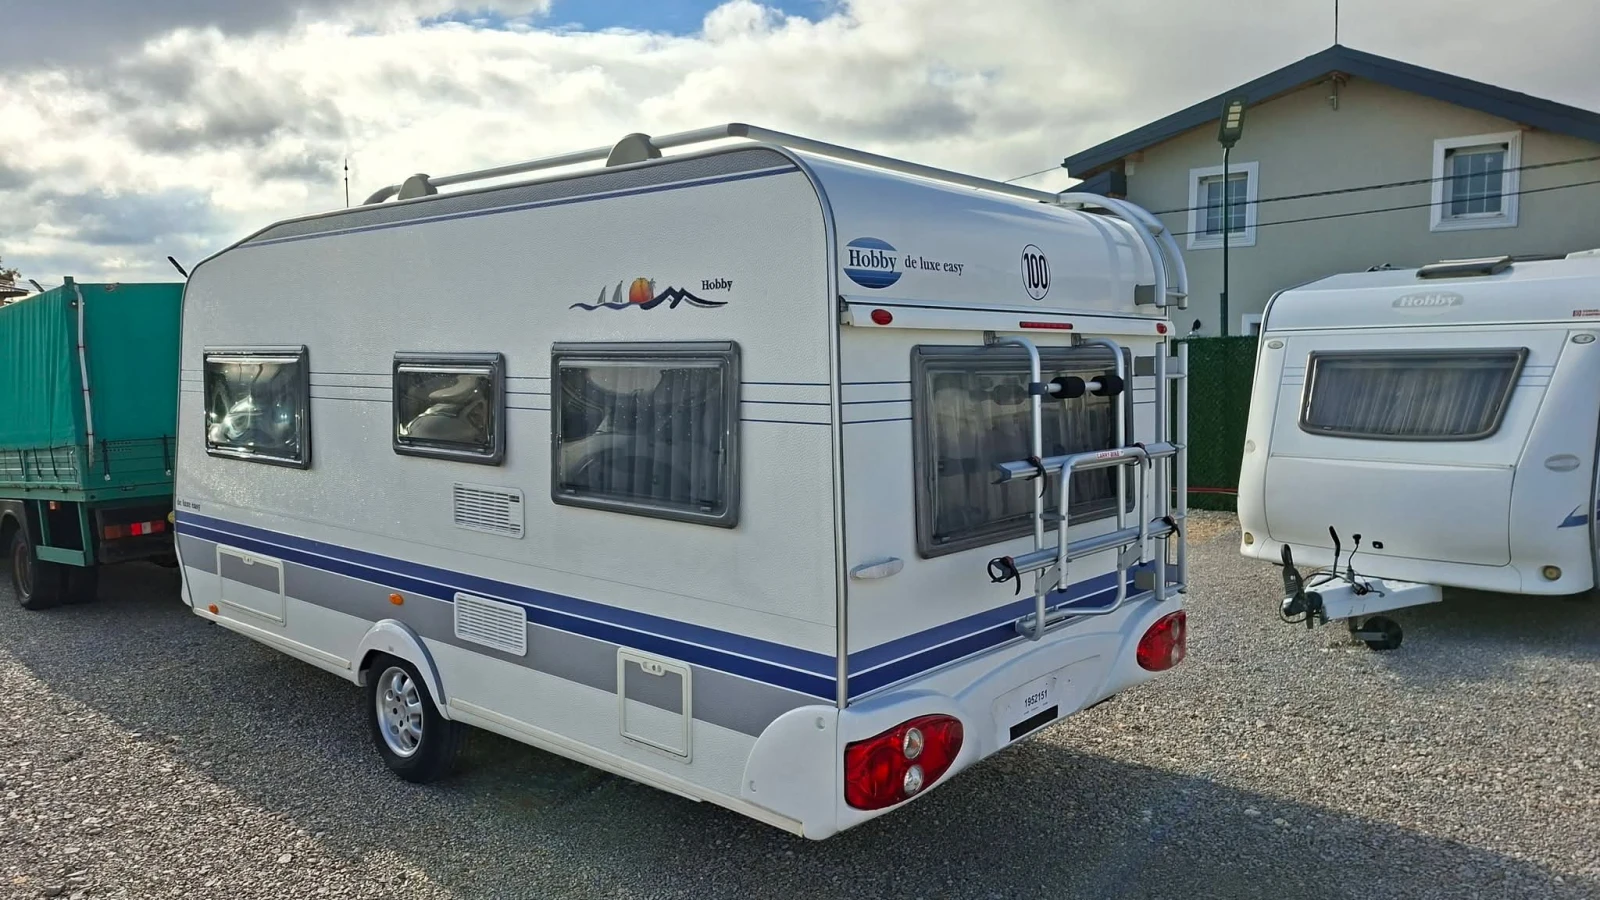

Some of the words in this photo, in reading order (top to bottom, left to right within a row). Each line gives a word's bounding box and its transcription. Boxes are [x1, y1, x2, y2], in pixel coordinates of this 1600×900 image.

[848, 249, 897, 273] Hobby
[904, 255, 917, 269] de
[920, 256, 941, 271] luxe
[943, 262, 964, 276] easy
[1024, 252, 1048, 289] 100
[701, 278, 733, 292] Hobby
[1400, 293, 1457, 307] Hobby
[1024, 689, 1048, 707] 1952151
